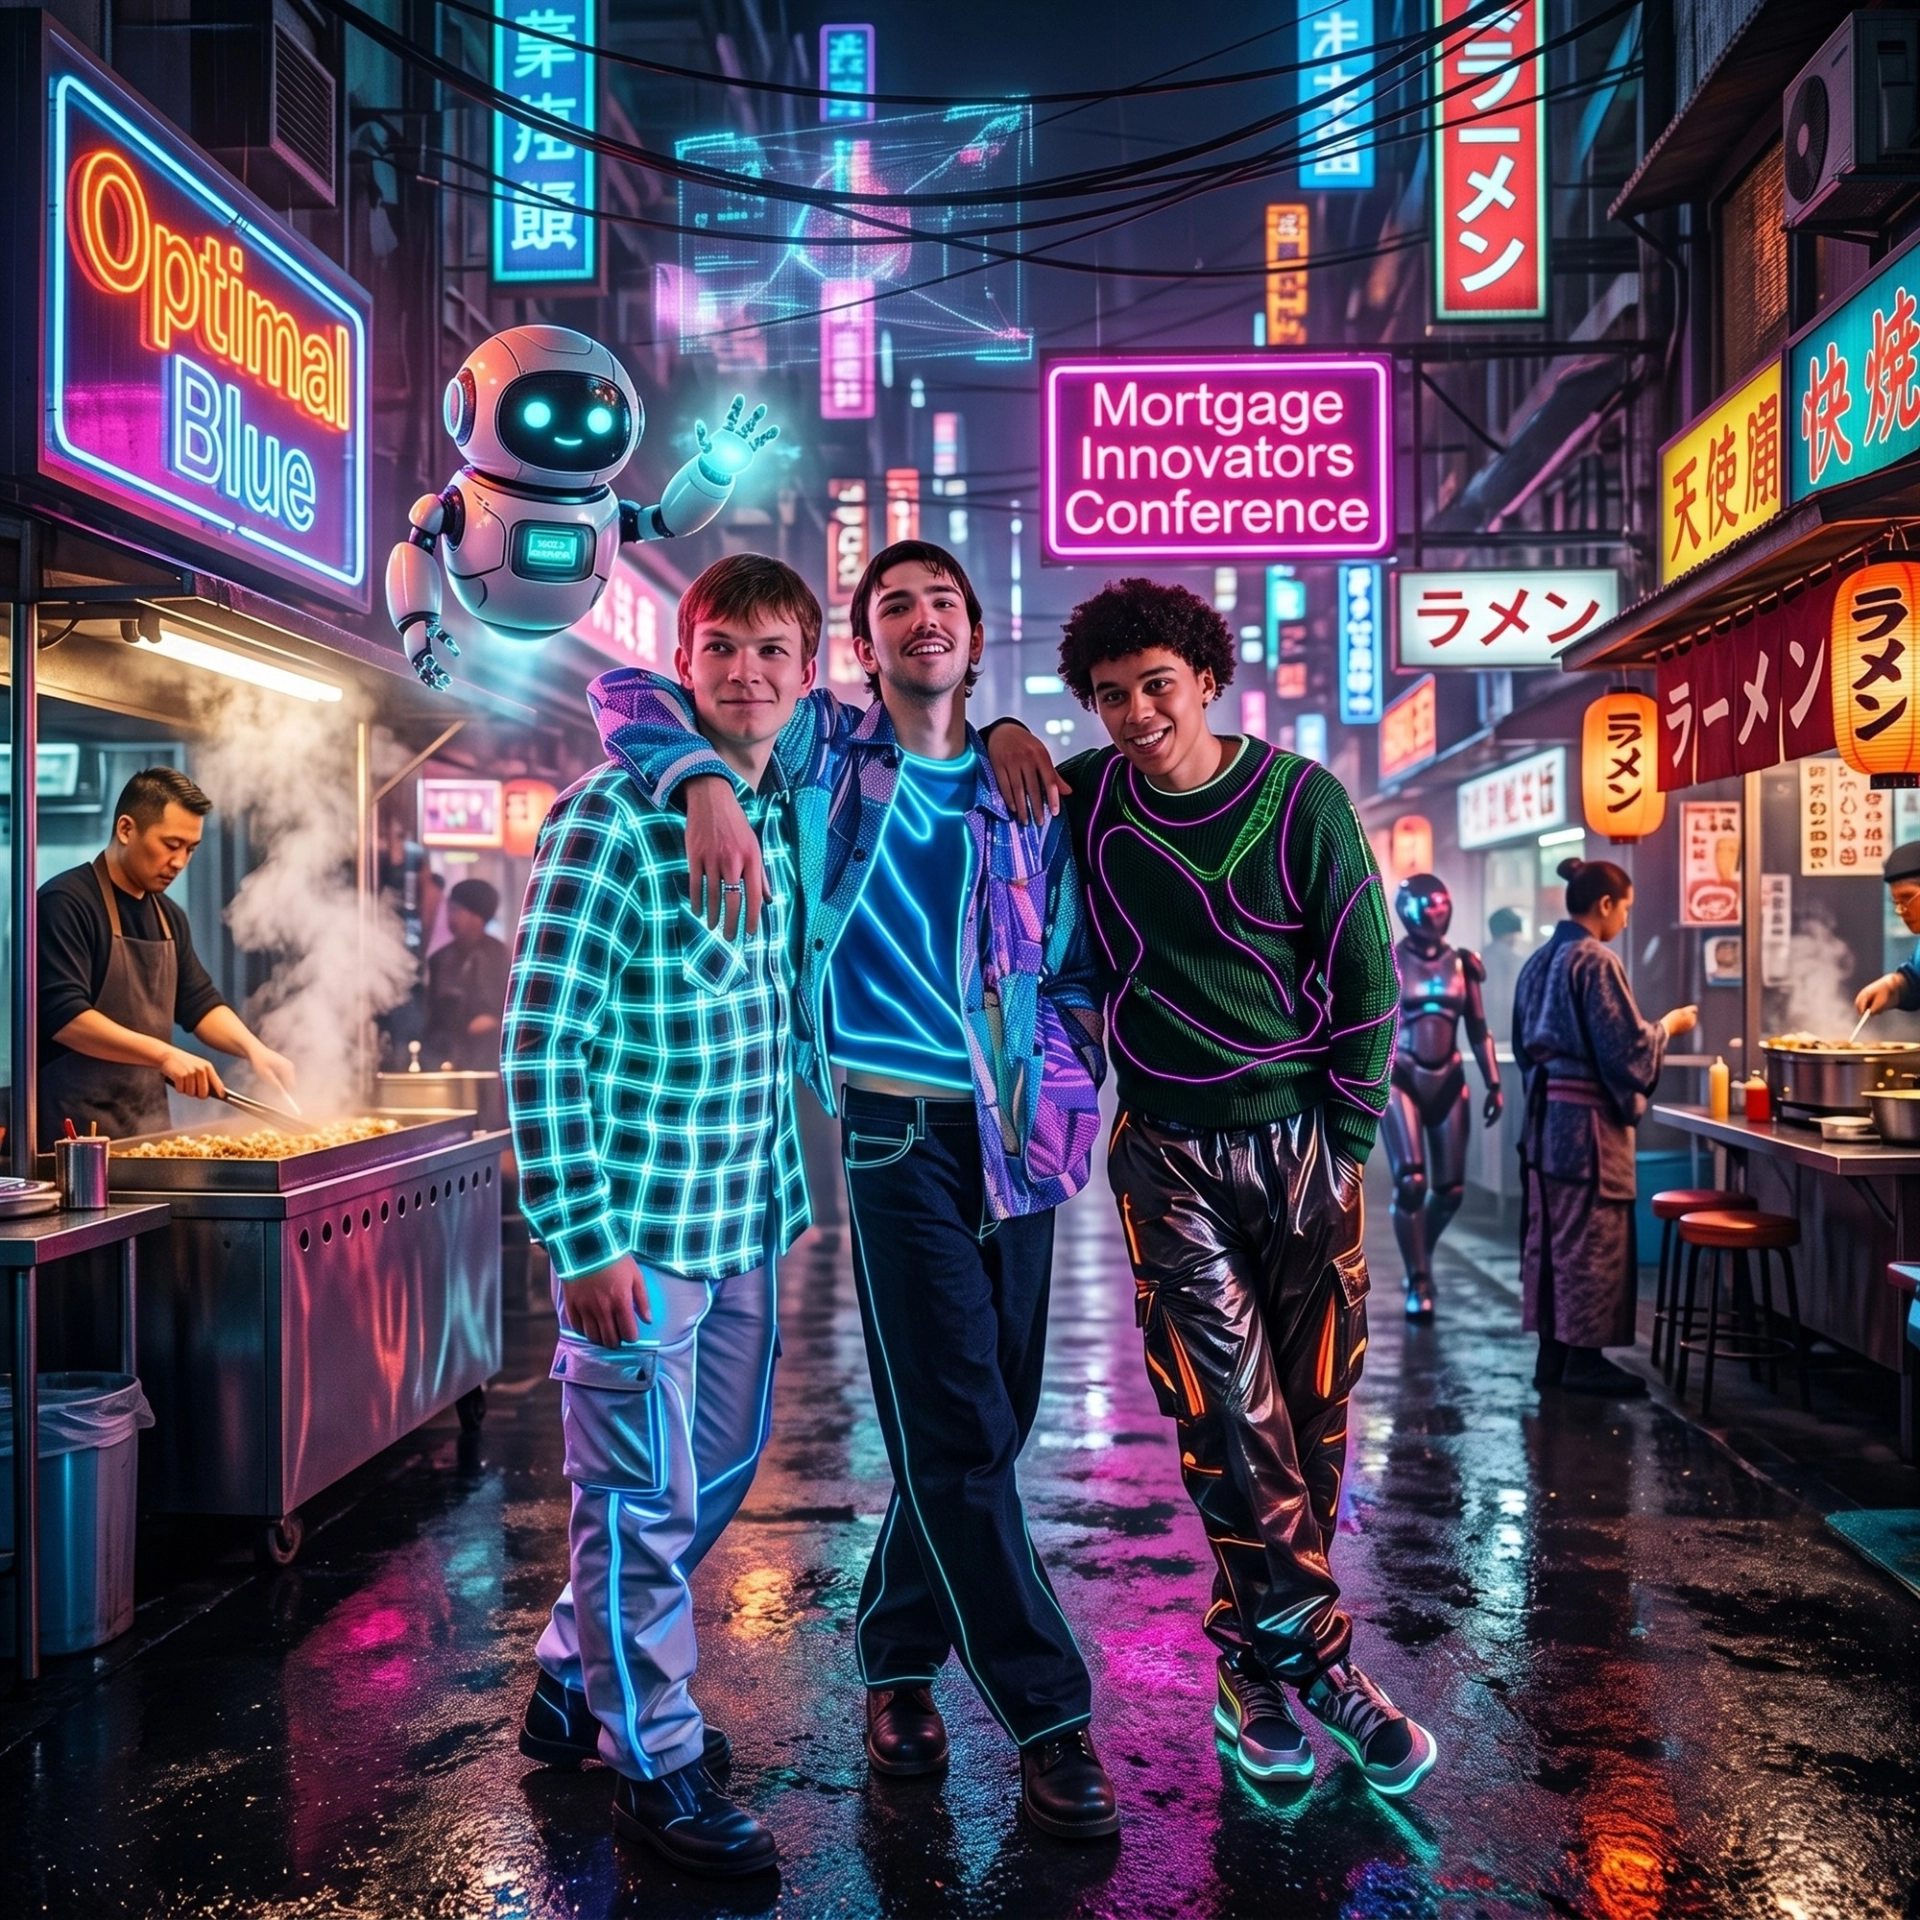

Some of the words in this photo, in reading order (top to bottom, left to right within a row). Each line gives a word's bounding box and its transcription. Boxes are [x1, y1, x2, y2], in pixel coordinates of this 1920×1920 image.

[70, 150, 350, 432] Optimal
[173, 354, 316, 533] Blue
[1093, 381, 1344, 437] Mortgage
[1081, 435, 1355, 480] Innovators
[1065, 488, 1370, 535] Conference
[1417, 588, 1600, 648] ラメン
[1851, 586, 1908, 742] ラメン
[1666, 636, 1825, 769] ラーメン
